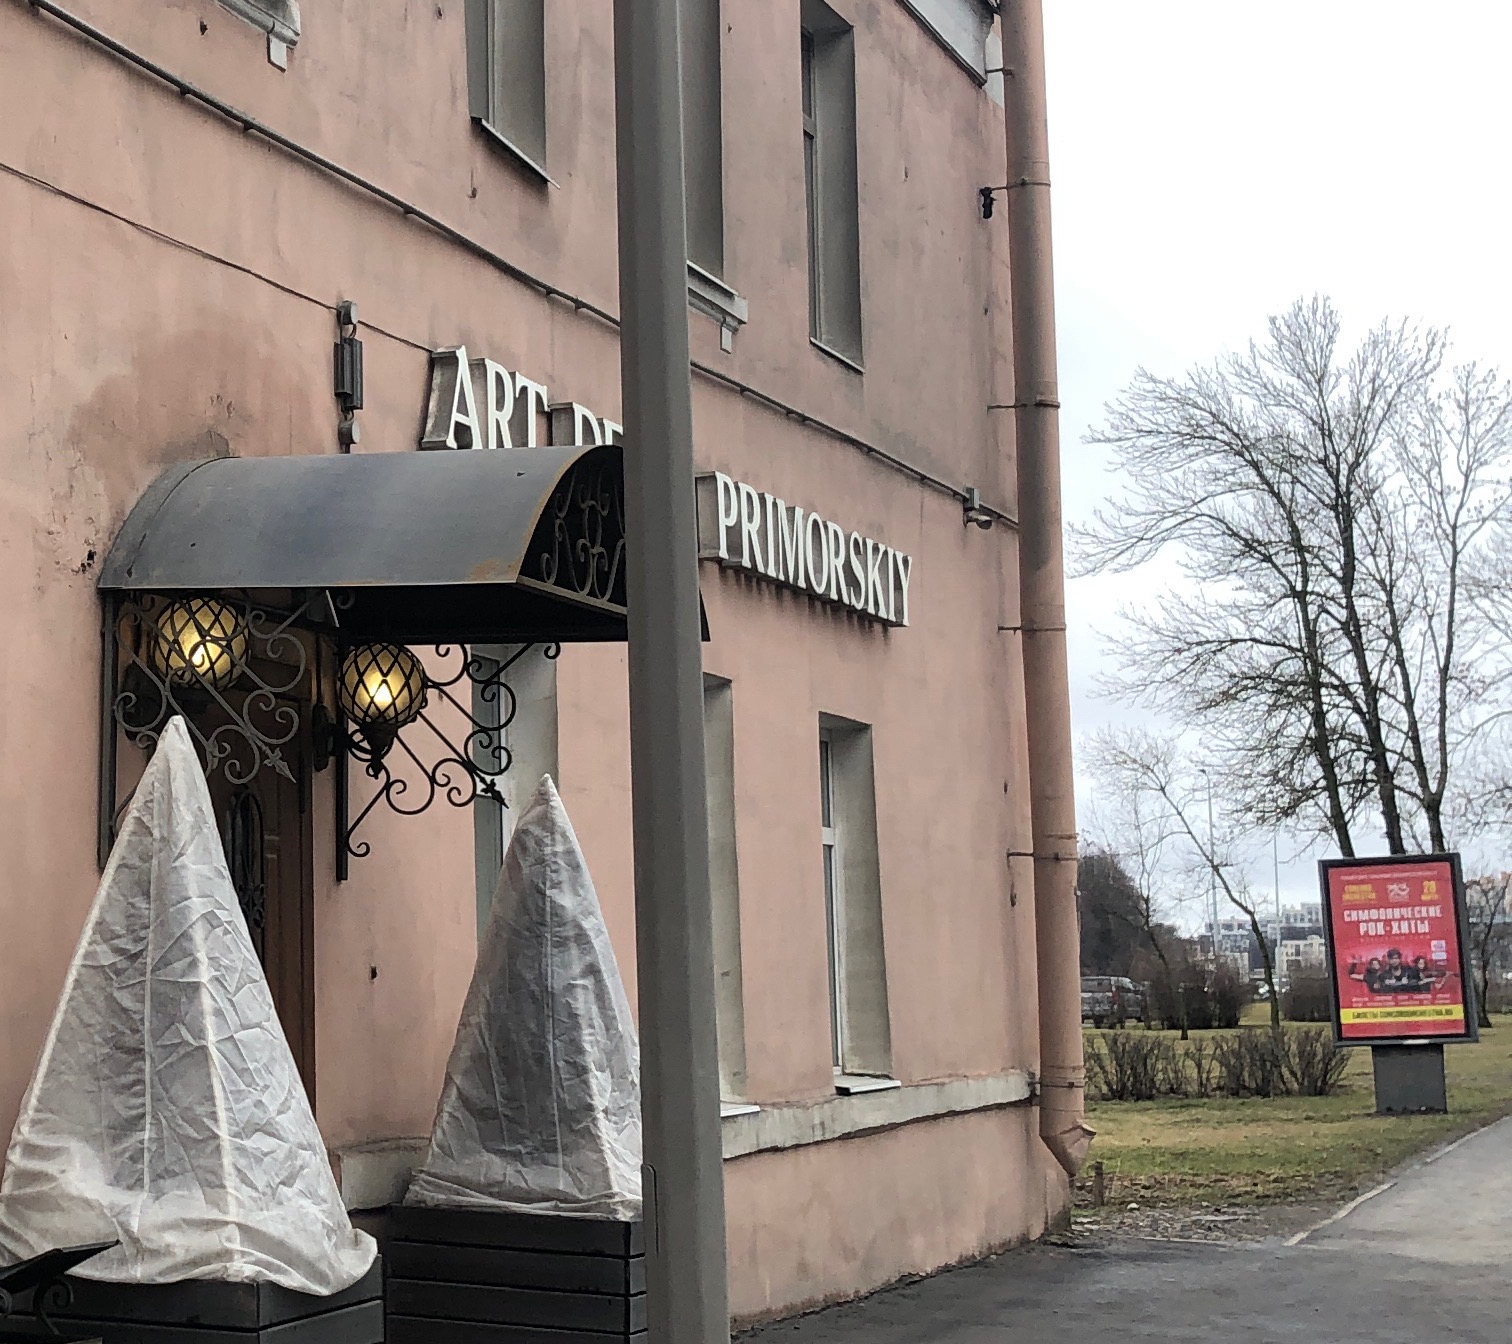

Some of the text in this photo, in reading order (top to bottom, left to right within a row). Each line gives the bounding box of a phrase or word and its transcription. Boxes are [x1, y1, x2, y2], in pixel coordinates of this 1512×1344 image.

[445, 345, 550, 449] ART
[715, 471, 912, 626] PRIMORSKIY
[1343, 905, 1442, 922] СИМФОНИЧЕСКИЕ
[1359, 920, 1429, 936] РОК-ХИТЫ
